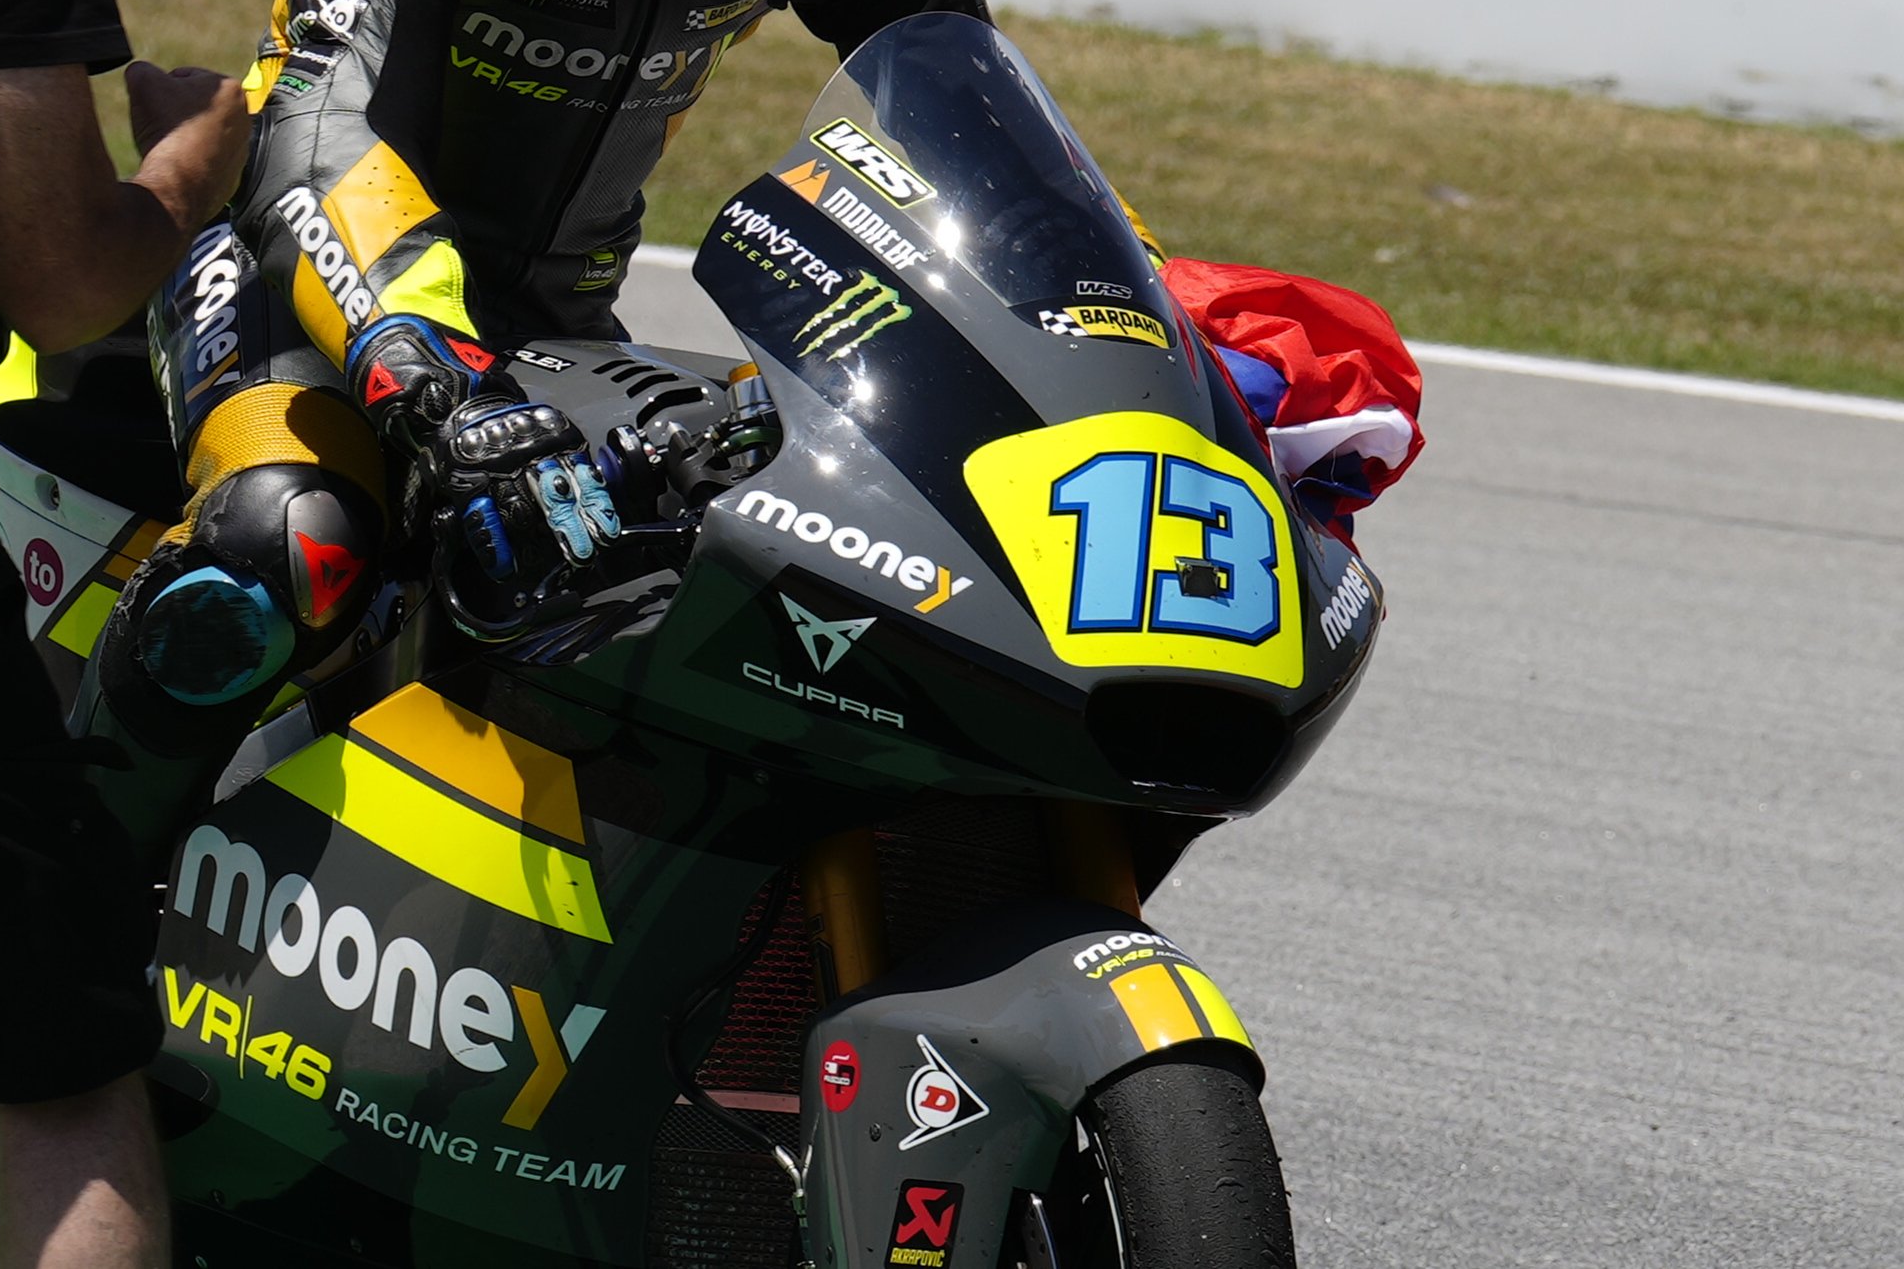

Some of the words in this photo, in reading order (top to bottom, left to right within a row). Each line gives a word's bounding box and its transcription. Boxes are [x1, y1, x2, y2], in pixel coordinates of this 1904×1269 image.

[567, 96, 642, 114] RACNG
[819, 122, 928, 198] WRS
[720, 231, 802, 292] ENERGY
[722, 199, 844, 296] MONSTER
[1076, 280, 1133, 300] WRS
[1078, 308, 1165, 340] BARDAHL
[29, 550, 57, 592] to
[735, 488, 974, 614] mooney
[1051, 450, 1279, 647] 13
[1319, 554, 1381, 651] mooney
[742, 661, 905, 730] CUPRA
[173, 824, 608, 1131] mooney
[335, 1087, 478, 1165] RACING
[492, 1146, 627, 1191] TEAM
